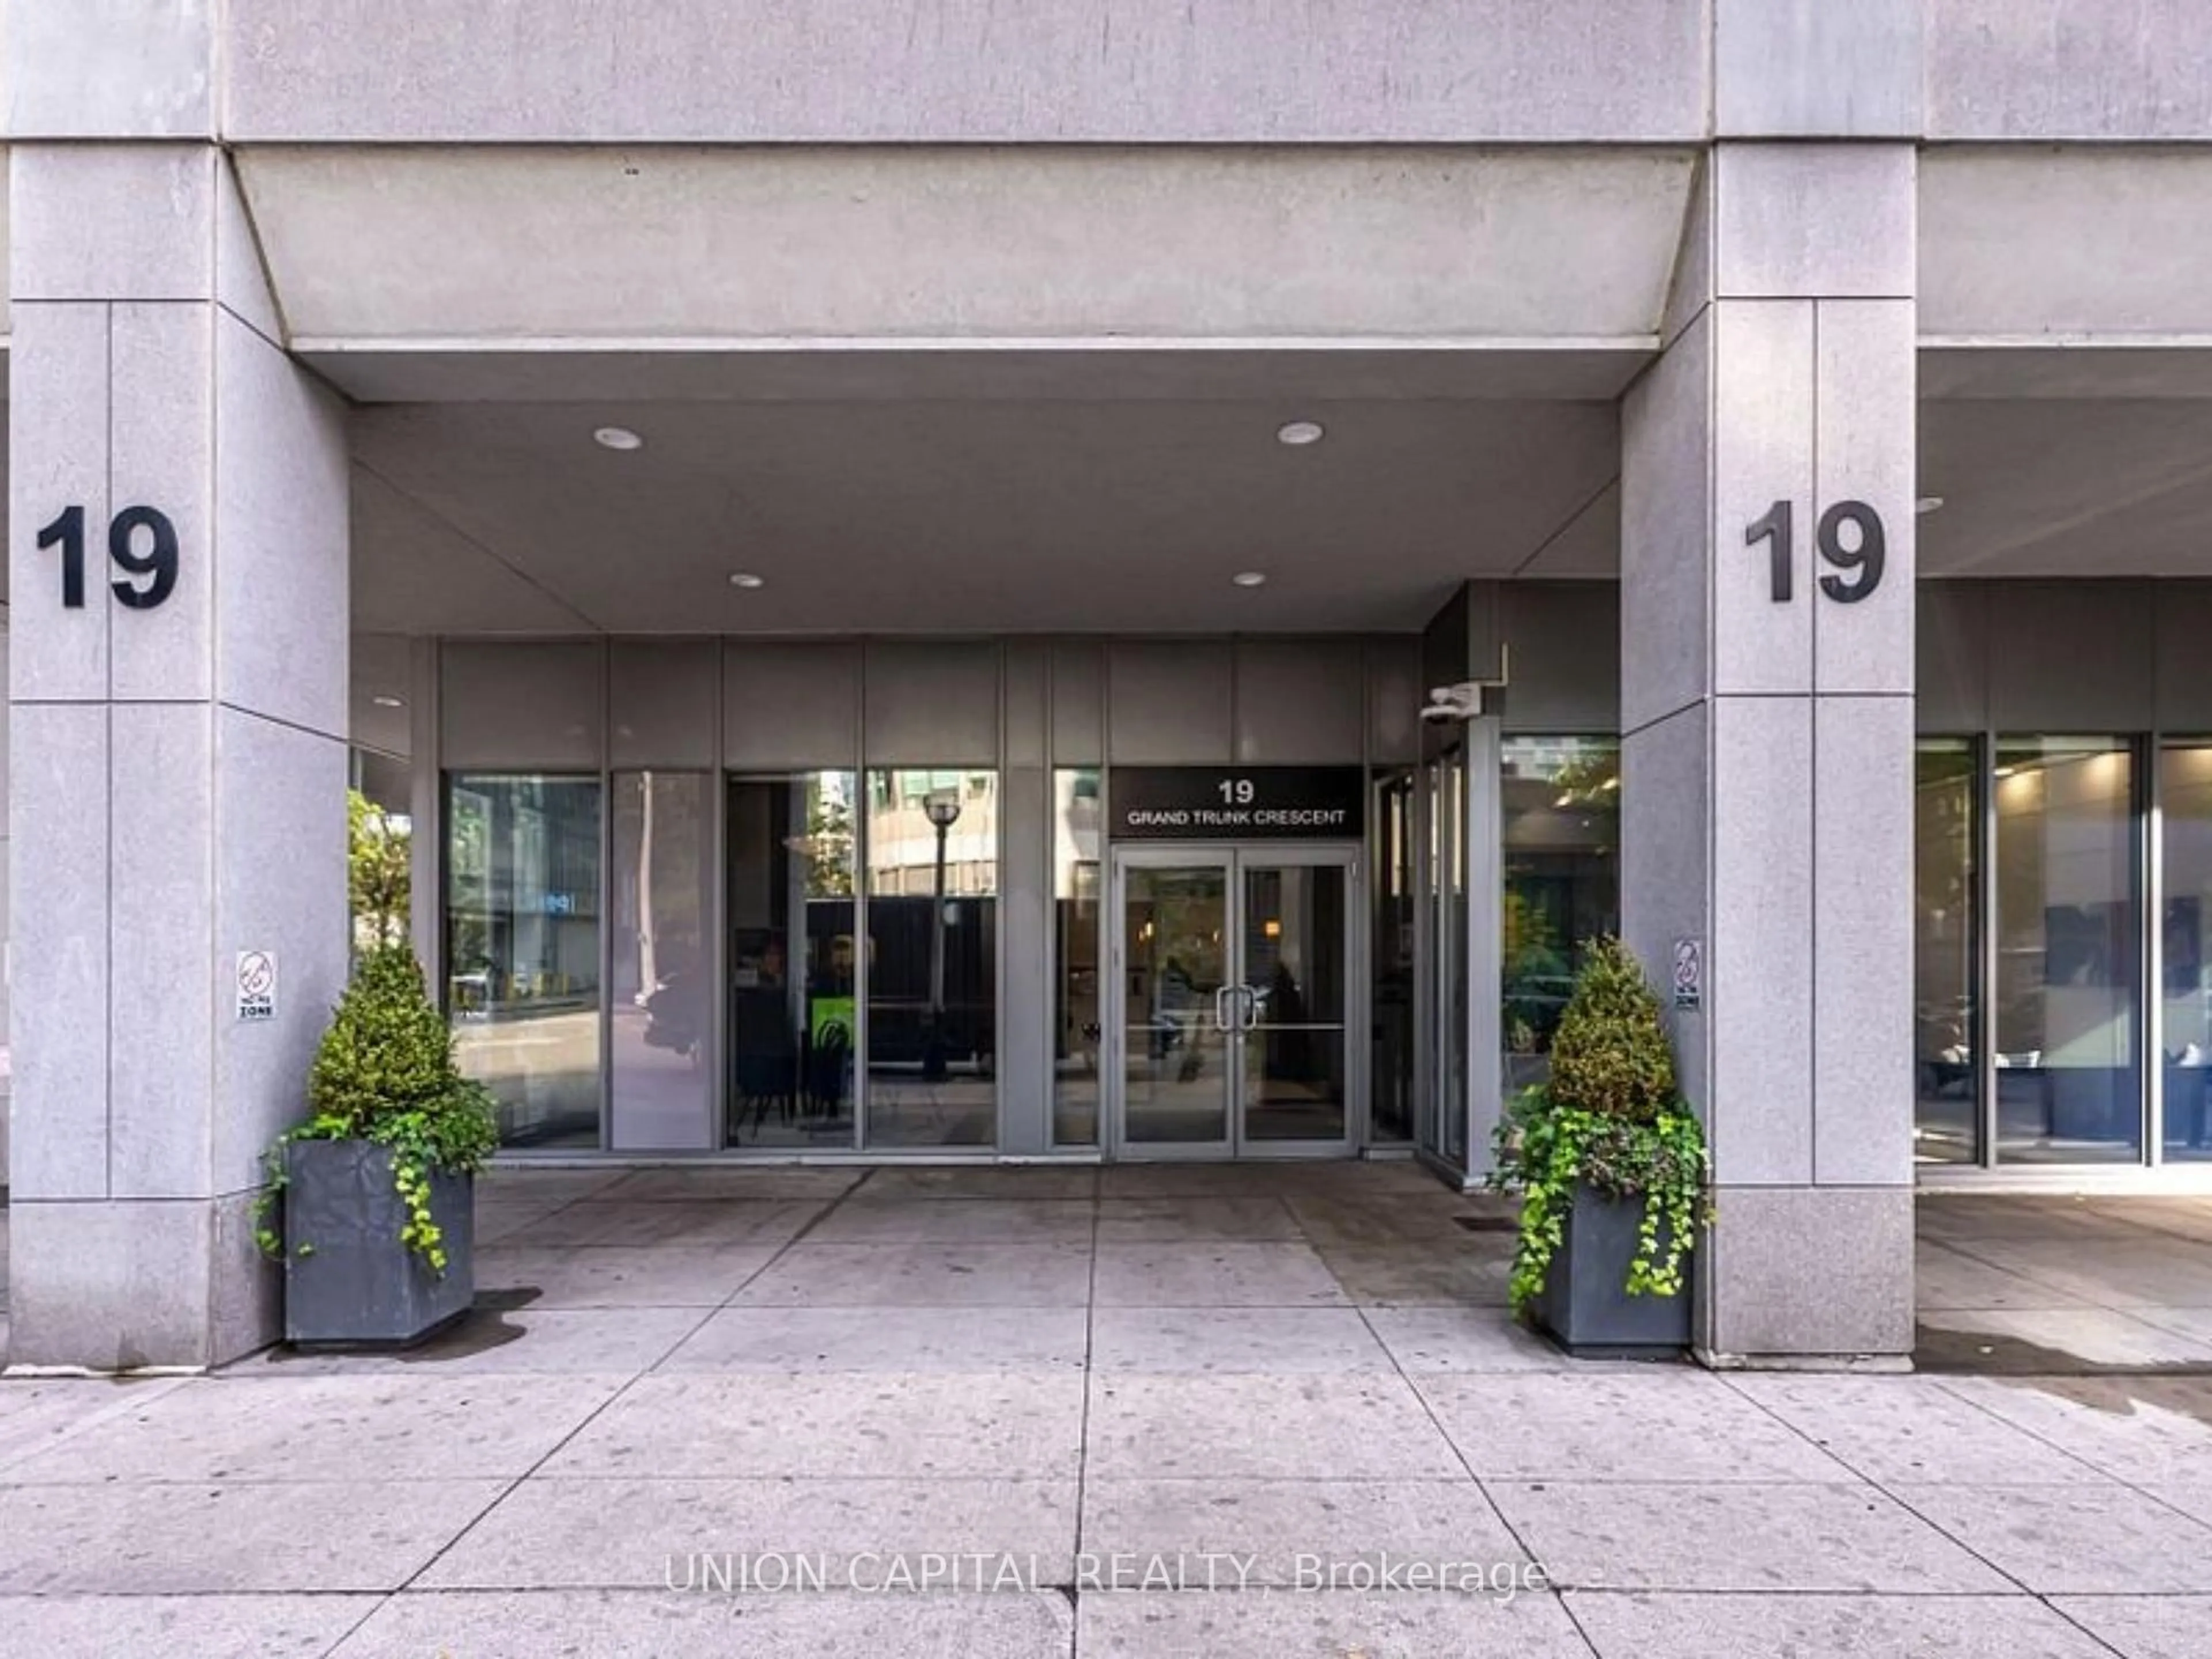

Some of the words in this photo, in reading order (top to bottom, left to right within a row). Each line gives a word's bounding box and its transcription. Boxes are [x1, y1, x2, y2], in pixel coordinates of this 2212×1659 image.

[37, 505, 179, 609] 19
[1745, 500, 1885, 603] 19
[1127, 810, 1190, 825] GRAND
[1193, 810, 1249, 825] TRUNK
[1253, 810, 1346, 825] CRESCENT
[1218, 779, 1255, 804] 19
